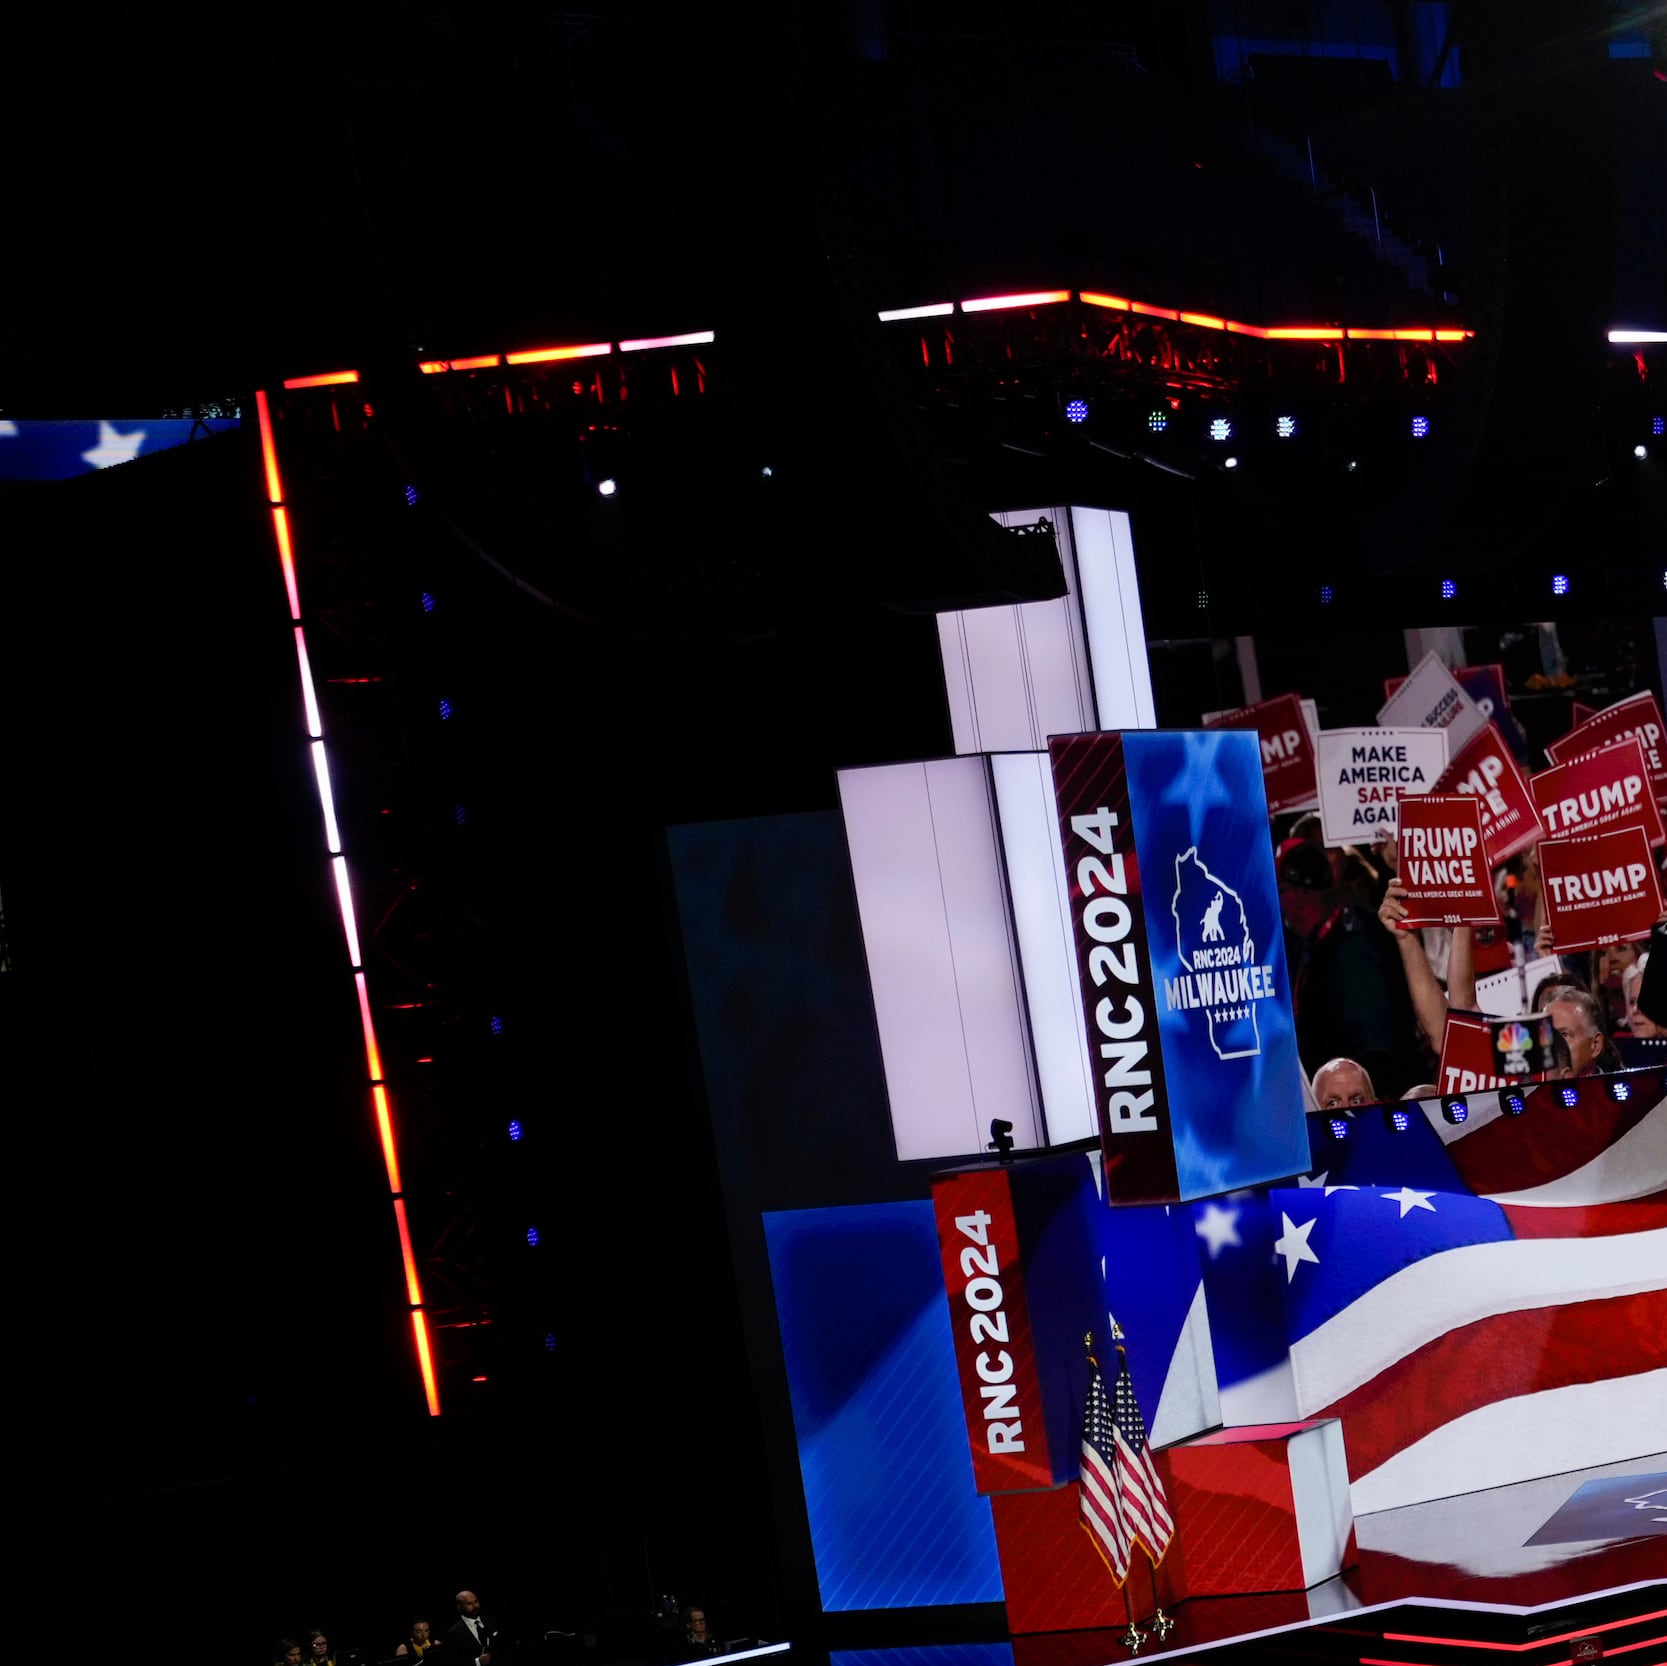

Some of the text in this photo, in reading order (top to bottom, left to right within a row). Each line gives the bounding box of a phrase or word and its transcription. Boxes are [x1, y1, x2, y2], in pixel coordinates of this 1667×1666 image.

[1351, 746, 1407, 763] MAKE
[1338, 766, 1425, 785] AMERICA
[1541, 775, 1642, 832] TRUMP
[1353, 807, 1396, 825] AGAI
[1402, 827, 1478, 858] TRUMP
[1408, 859, 1476, 885] VANCE
[1548, 863, 1647, 903] TRUMP
[1557, 903, 1573, 912] MAKE
[1574, 899, 1600, 910] AMERICA
[1601, 896, 1622, 906] GREAT
[1443, 914, 1462, 923] 2024
[1597, 934, 1619, 945] 2024
[1164, 964, 1276, 1011] MILWAUKEE
